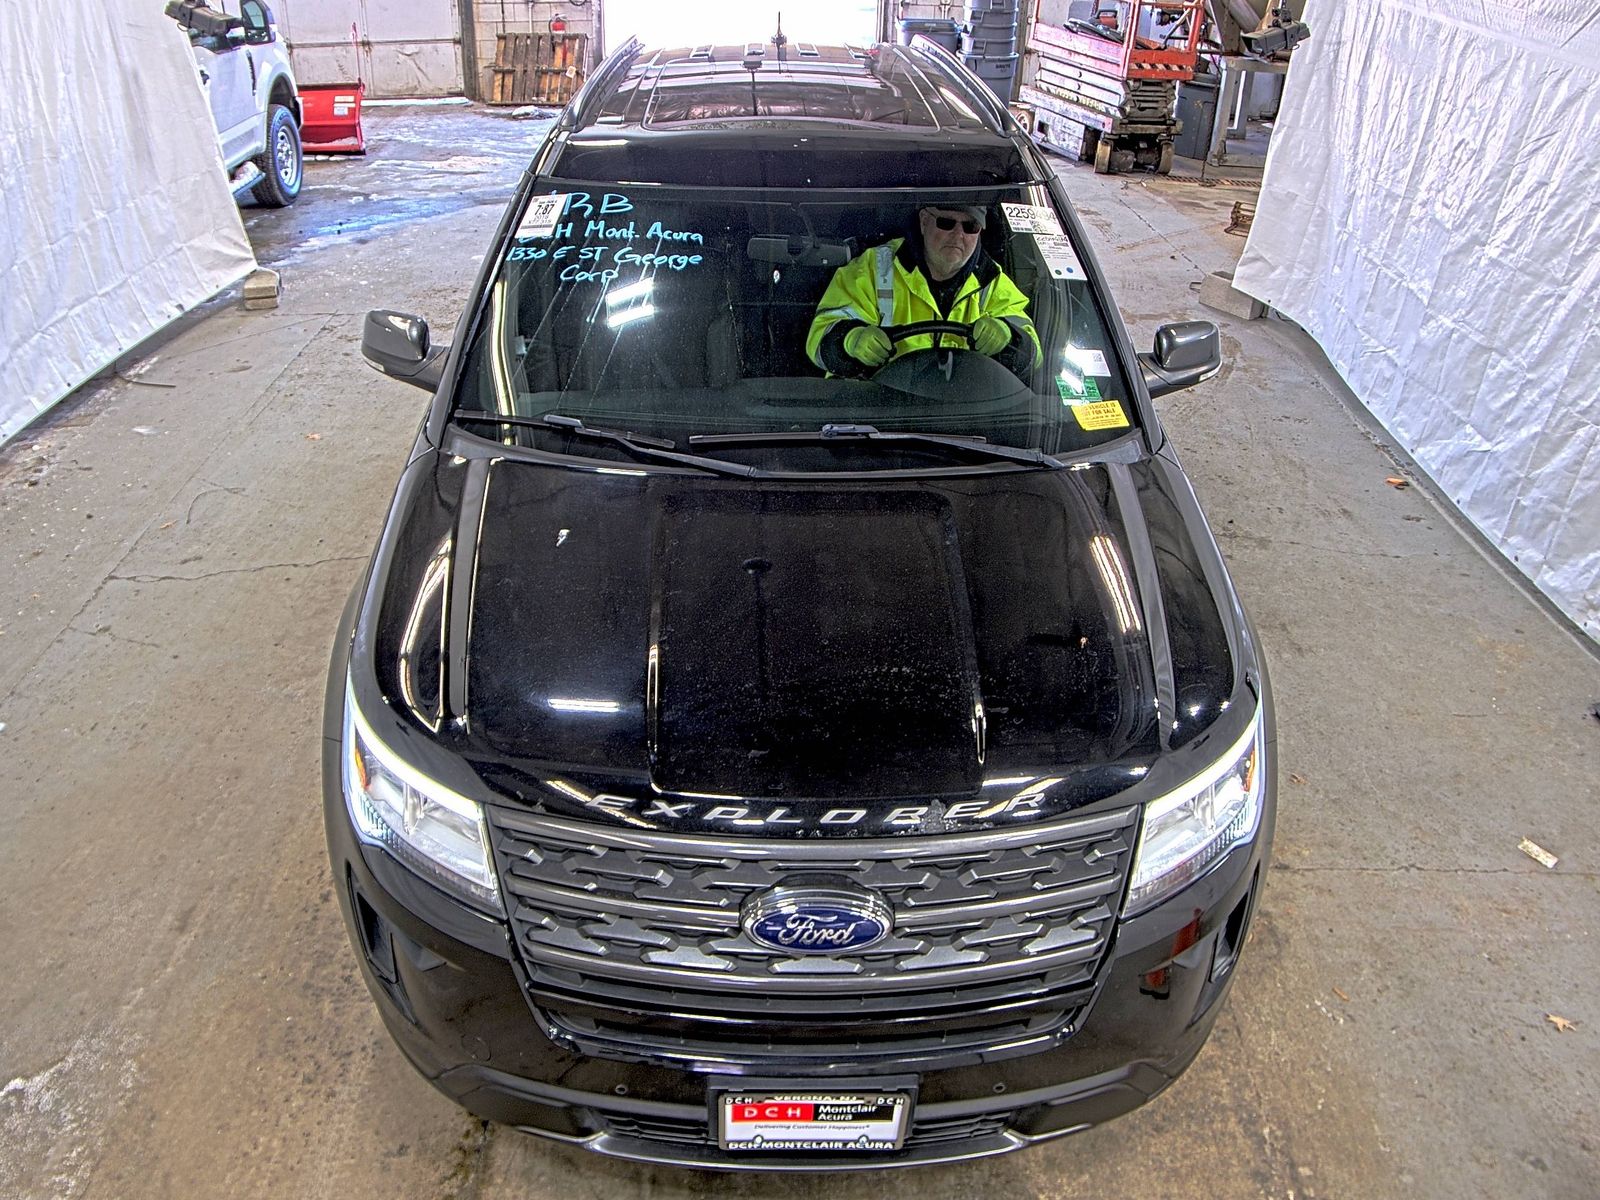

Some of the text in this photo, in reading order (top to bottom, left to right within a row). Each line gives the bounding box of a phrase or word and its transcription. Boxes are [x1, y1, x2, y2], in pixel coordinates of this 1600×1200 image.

[646, 221, 704, 245] Acura
[506, 246, 547, 261] 1330
[552, 245, 576, 260] E
[613, 247, 703, 270] George
[559, 264, 619, 284] Corp
[587, 791, 1046, 825] EXPLORER
[779, 912, 855, 947] Ford
[817, 1113, 853, 1121] Acura
[818, 1104, 878, 1114] Montclair
[761, 1140, 843, 1149] MONTCLAIR
[846, 1141, 894, 1150] ACURA
